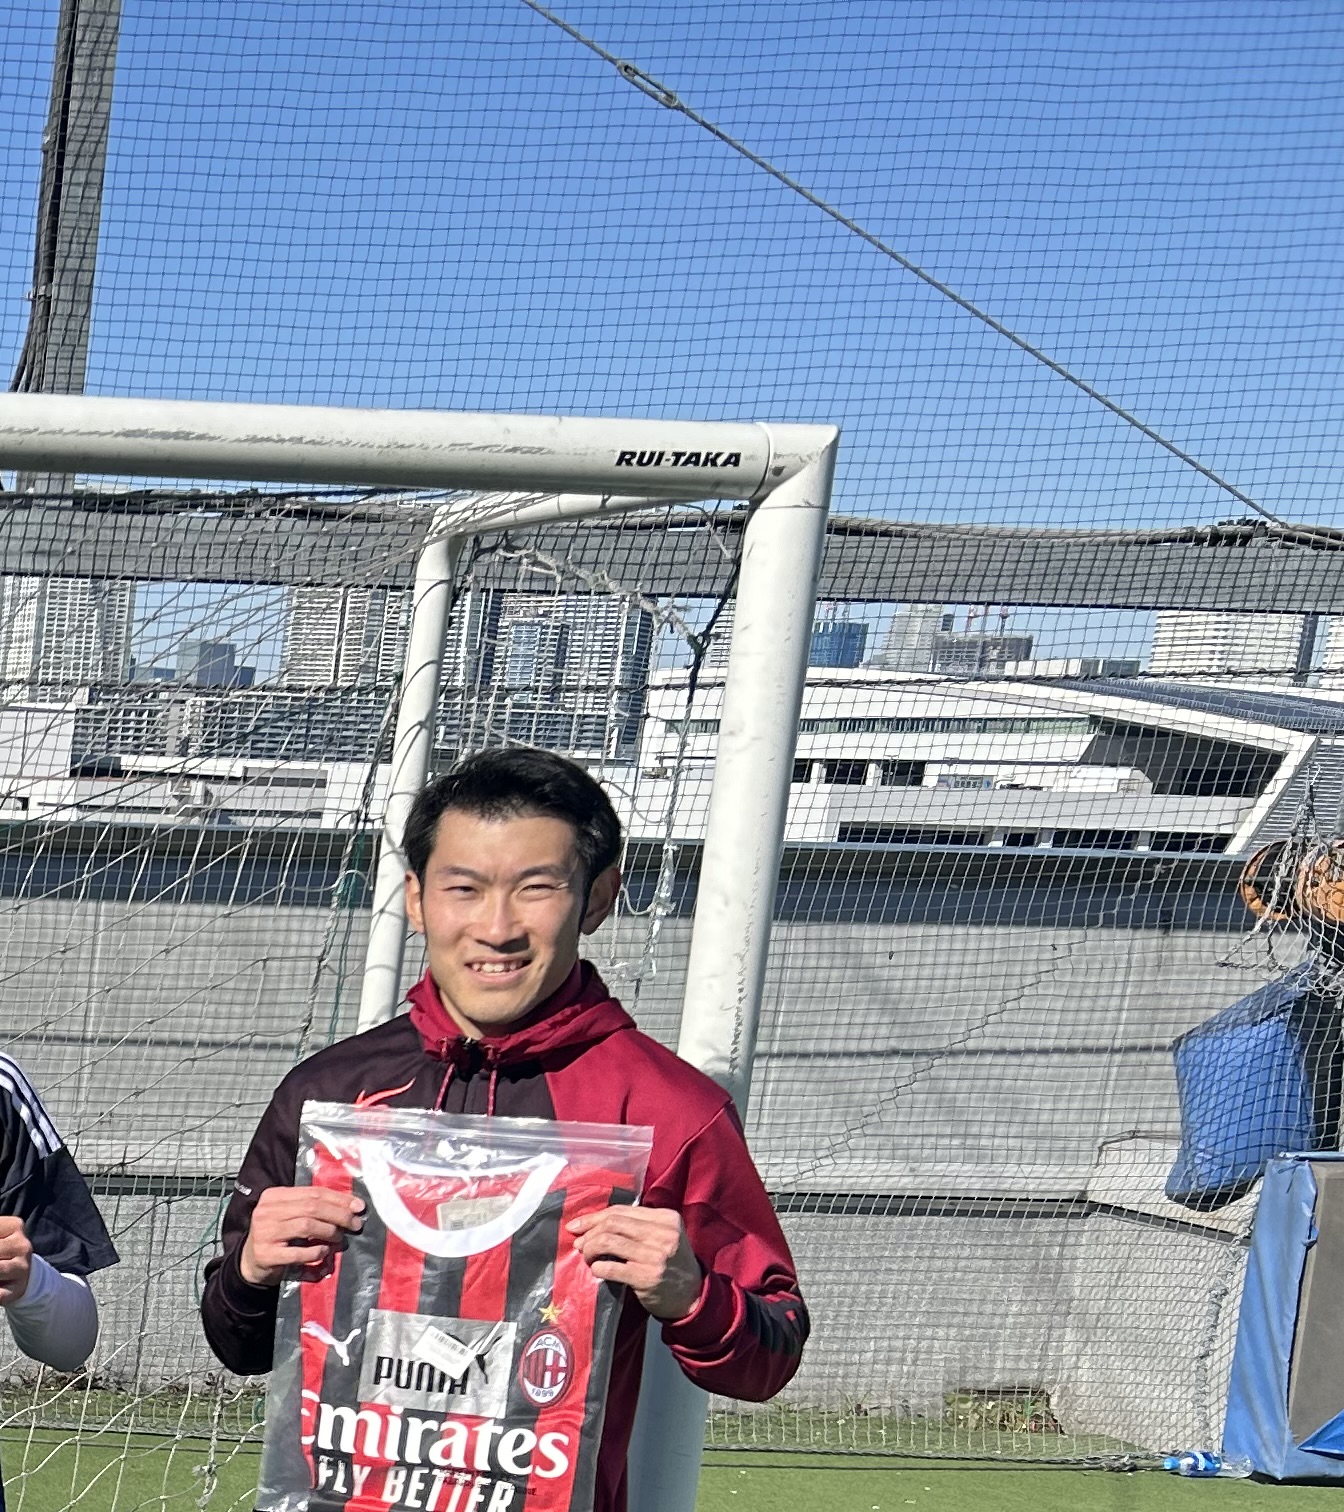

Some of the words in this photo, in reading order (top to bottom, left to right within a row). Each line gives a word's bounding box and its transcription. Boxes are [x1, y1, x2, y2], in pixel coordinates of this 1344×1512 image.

[615, 450, 742, 468] RUI-TAKA
[534, 1336, 561, 1350] ACM
[316, 1455, 372, 1497] FLY
